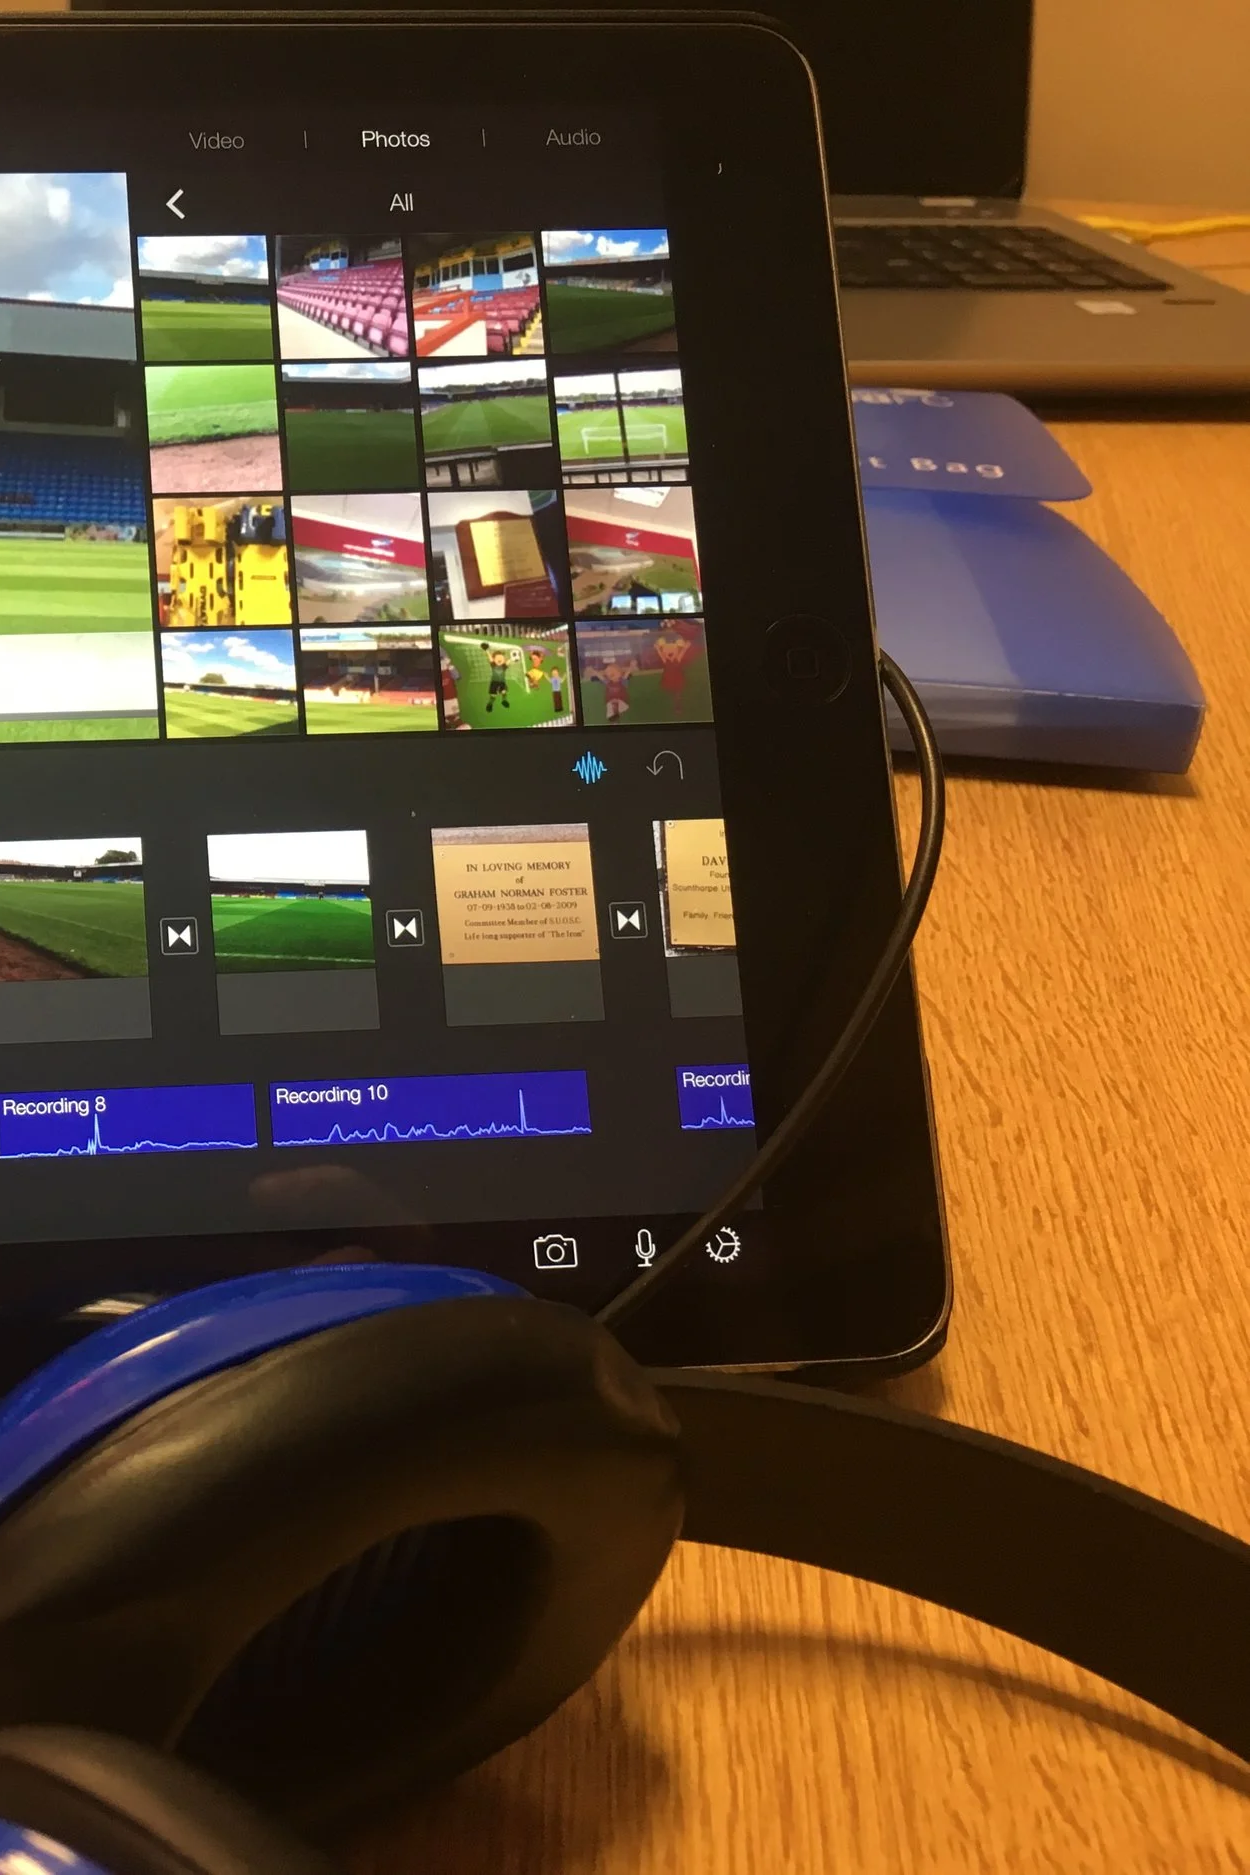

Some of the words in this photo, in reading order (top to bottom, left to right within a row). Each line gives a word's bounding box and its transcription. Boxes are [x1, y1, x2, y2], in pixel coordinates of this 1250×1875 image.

[189, 130, 245, 150] Video
[361, 129, 431, 149] Photos
[546, 127, 601, 147] Audio
[389, 192, 414, 212] All
[466, 863, 479, 873] IN
[482, 861, 524, 872] LOVING
[526, 860, 572, 871] MEMORY
[515, 876, 525, 884] of
[453, 890, 497, 900] GRAHAM
[500, 888, 546, 899] NORMAN
[549, 886, 589, 897] FOSTER
[672, 882, 719, 894] Scunthorpe
[507, 917, 538, 926] Member
[539, 917, 548, 926] of
[683, 910, 709, 921] Family
[464, 932, 481, 941] Life
[481, 931, 499, 942] long
[499, 930, 537, 941] supporter
[537, 929, 546, 939] of
[276, 1085, 361, 1104] Recording
[367, 1083, 389, 1101] 10
[3, 1098, 90, 1116] Recording
[94, 1096, 107, 1112] 8
